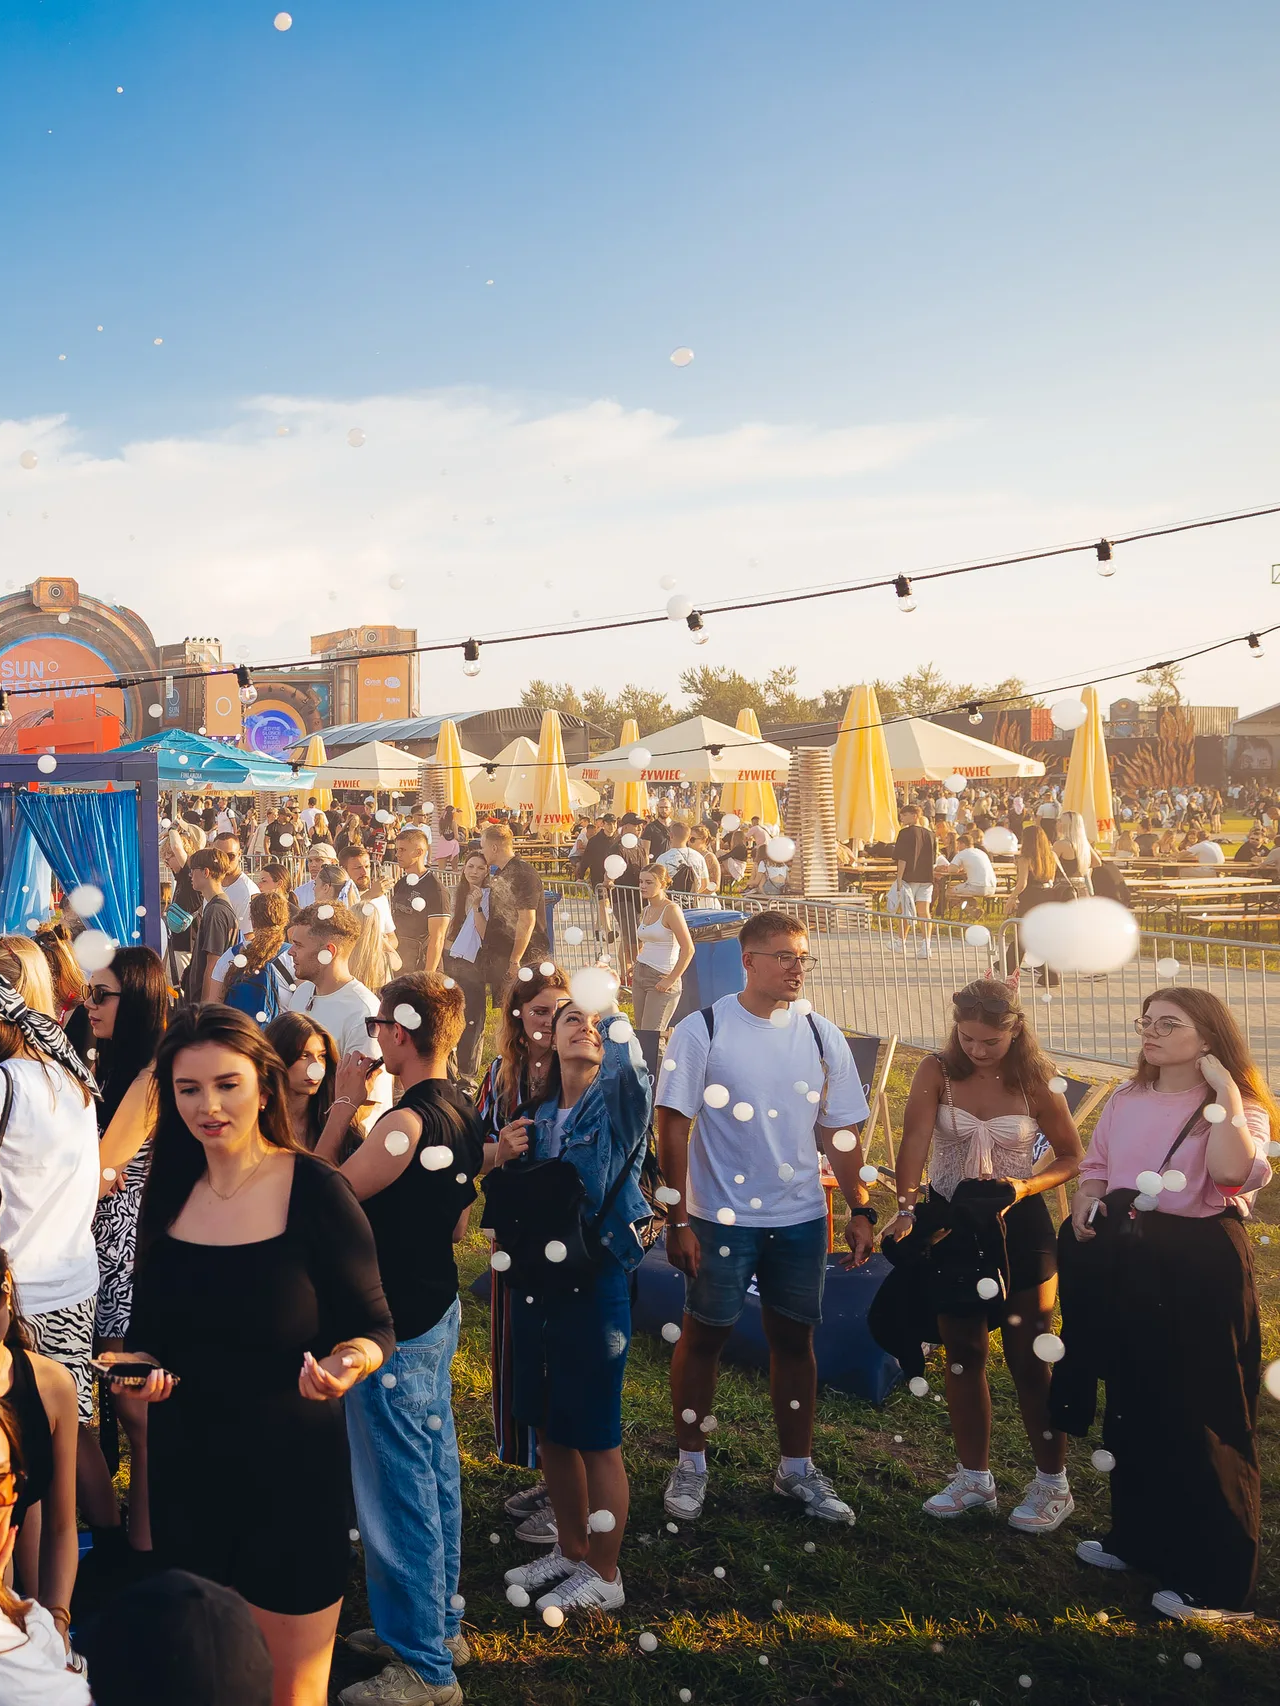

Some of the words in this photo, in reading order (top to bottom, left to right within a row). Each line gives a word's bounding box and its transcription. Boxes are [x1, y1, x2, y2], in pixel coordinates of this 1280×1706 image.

[1, 660, 44, 678] SUN
[1, 680, 102, 698] FESTIVAL
[640, 769, 680, 781] ŻYWIEC
[738, 769, 776, 781] ŻYWIEC
[333, 779, 360, 788] ŻYWIEC
